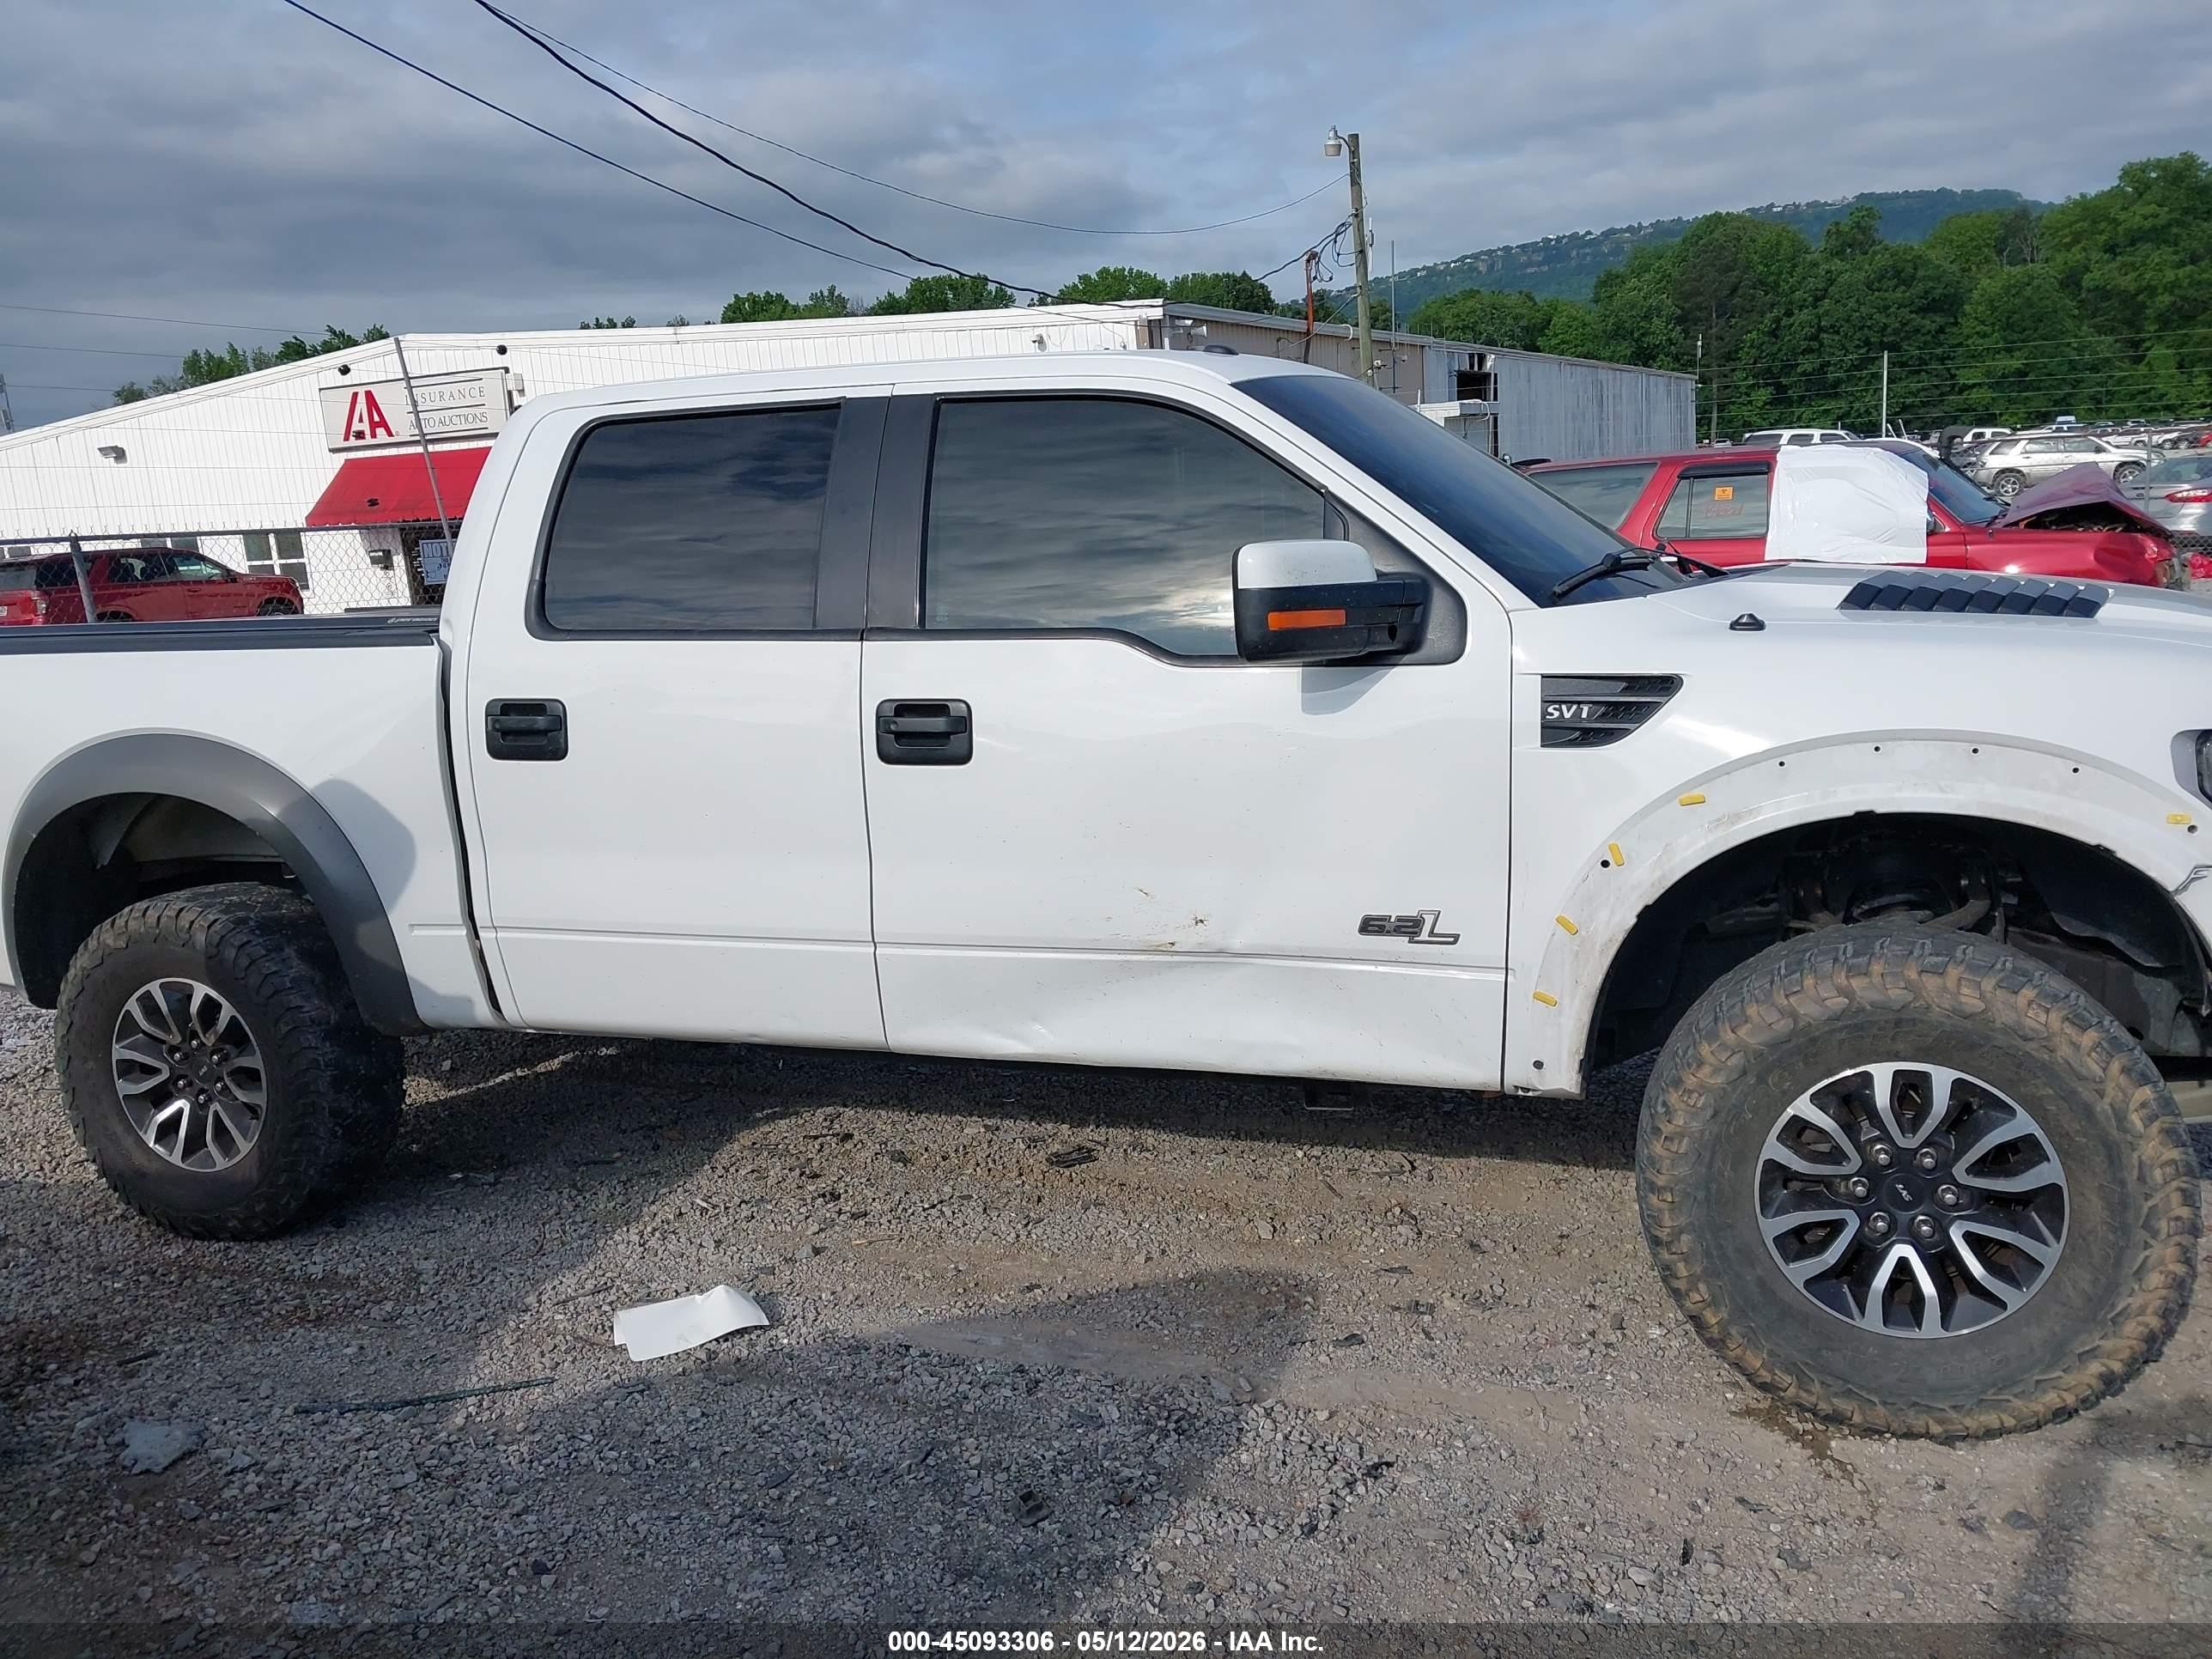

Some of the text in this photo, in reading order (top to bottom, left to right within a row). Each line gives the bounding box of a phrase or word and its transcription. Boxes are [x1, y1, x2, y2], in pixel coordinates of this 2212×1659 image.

[408, 412, 488, 430] ATO AUCTIONS
[1545, 703, 1593, 719] SVT
